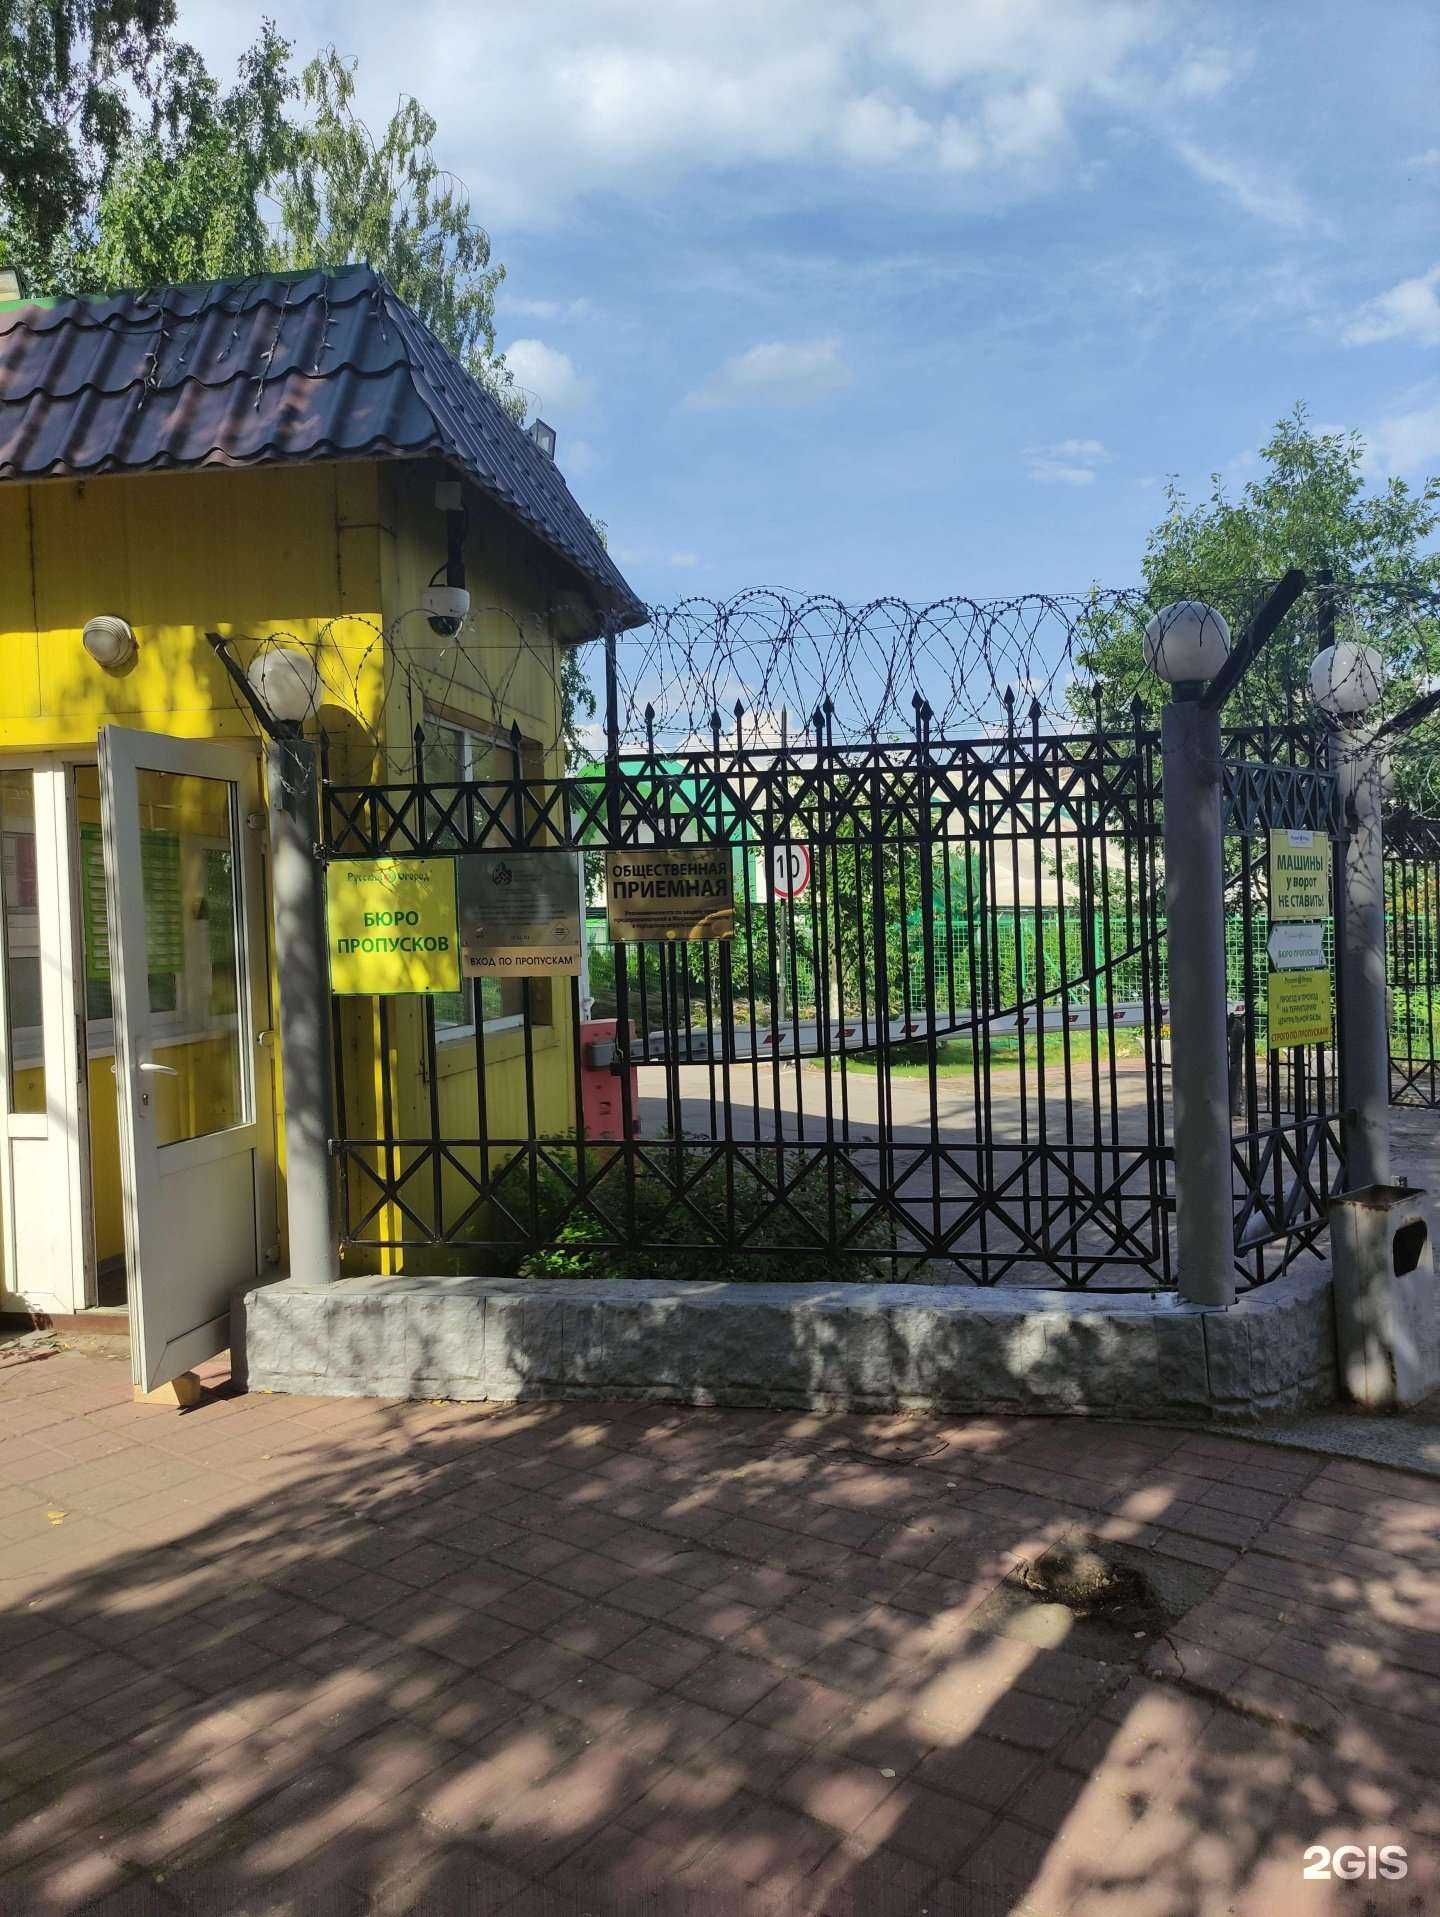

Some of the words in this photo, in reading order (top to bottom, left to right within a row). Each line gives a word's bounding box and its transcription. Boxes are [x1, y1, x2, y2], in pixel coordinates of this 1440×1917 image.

[612, 862, 727, 878] ОБЩЕСТВЕННАЯ
[776, 854, 800, 878] 10
[1277, 855, 1323, 870] МАШИНЫ
[613, 879, 728, 898] ПРИЕМНАЯ
[1286, 877, 1292, 891] у
[1293, 877, 1316, 891] ворот
[1278, 895, 1289, 908] НЕ
[364, 911, 419, 926] БЮРО
[337, 937, 449, 953] ПРОПУСКОВ
[470, 958, 496, 967] ВХОД
[499, 958, 512, 966] ПО
[515, 957, 573, 966] ПРОПУСКАМ
